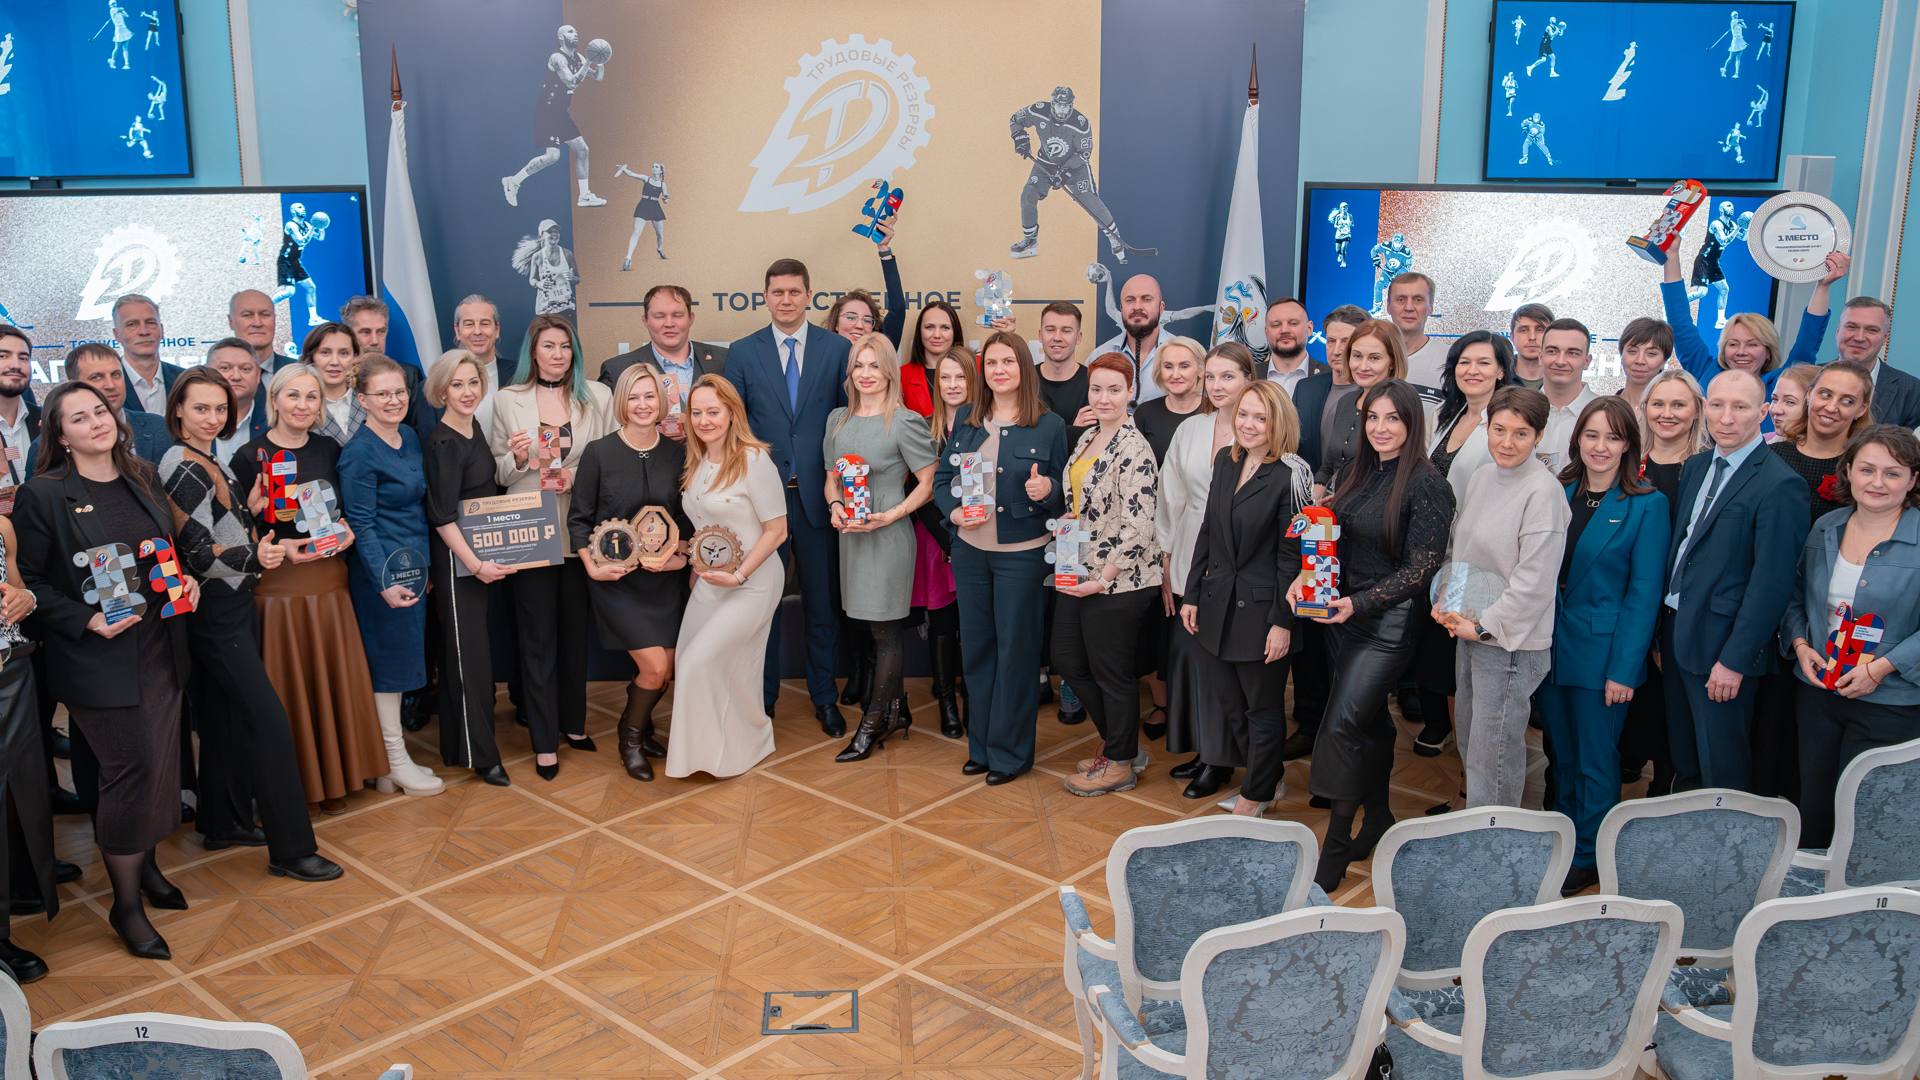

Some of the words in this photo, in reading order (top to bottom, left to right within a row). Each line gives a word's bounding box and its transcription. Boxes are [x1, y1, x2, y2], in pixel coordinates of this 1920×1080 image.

[807, 49, 898, 80] ТРУДОВЫЕ
[896, 72, 920, 151] РЕЗЕРВЫ
[1785, 234, 1819, 242] МЕСТО
[486, 515, 491, 523] 1
[493, 513, 521, 523] место
[472, 530, 504, 549] 500
[508, 526, 540, 545] 000
[396, 568, 421, 579] МЕСТО
[1716, 796, 1722, 807] 2
[1490, 816, 1496, 826] 6
[1876, 897, 1888, 908] 10
[1601, 904, 1607, 915] 9
[1320, 918, 1325, 929] 1
[134, 1026, 150, 1039] 12
